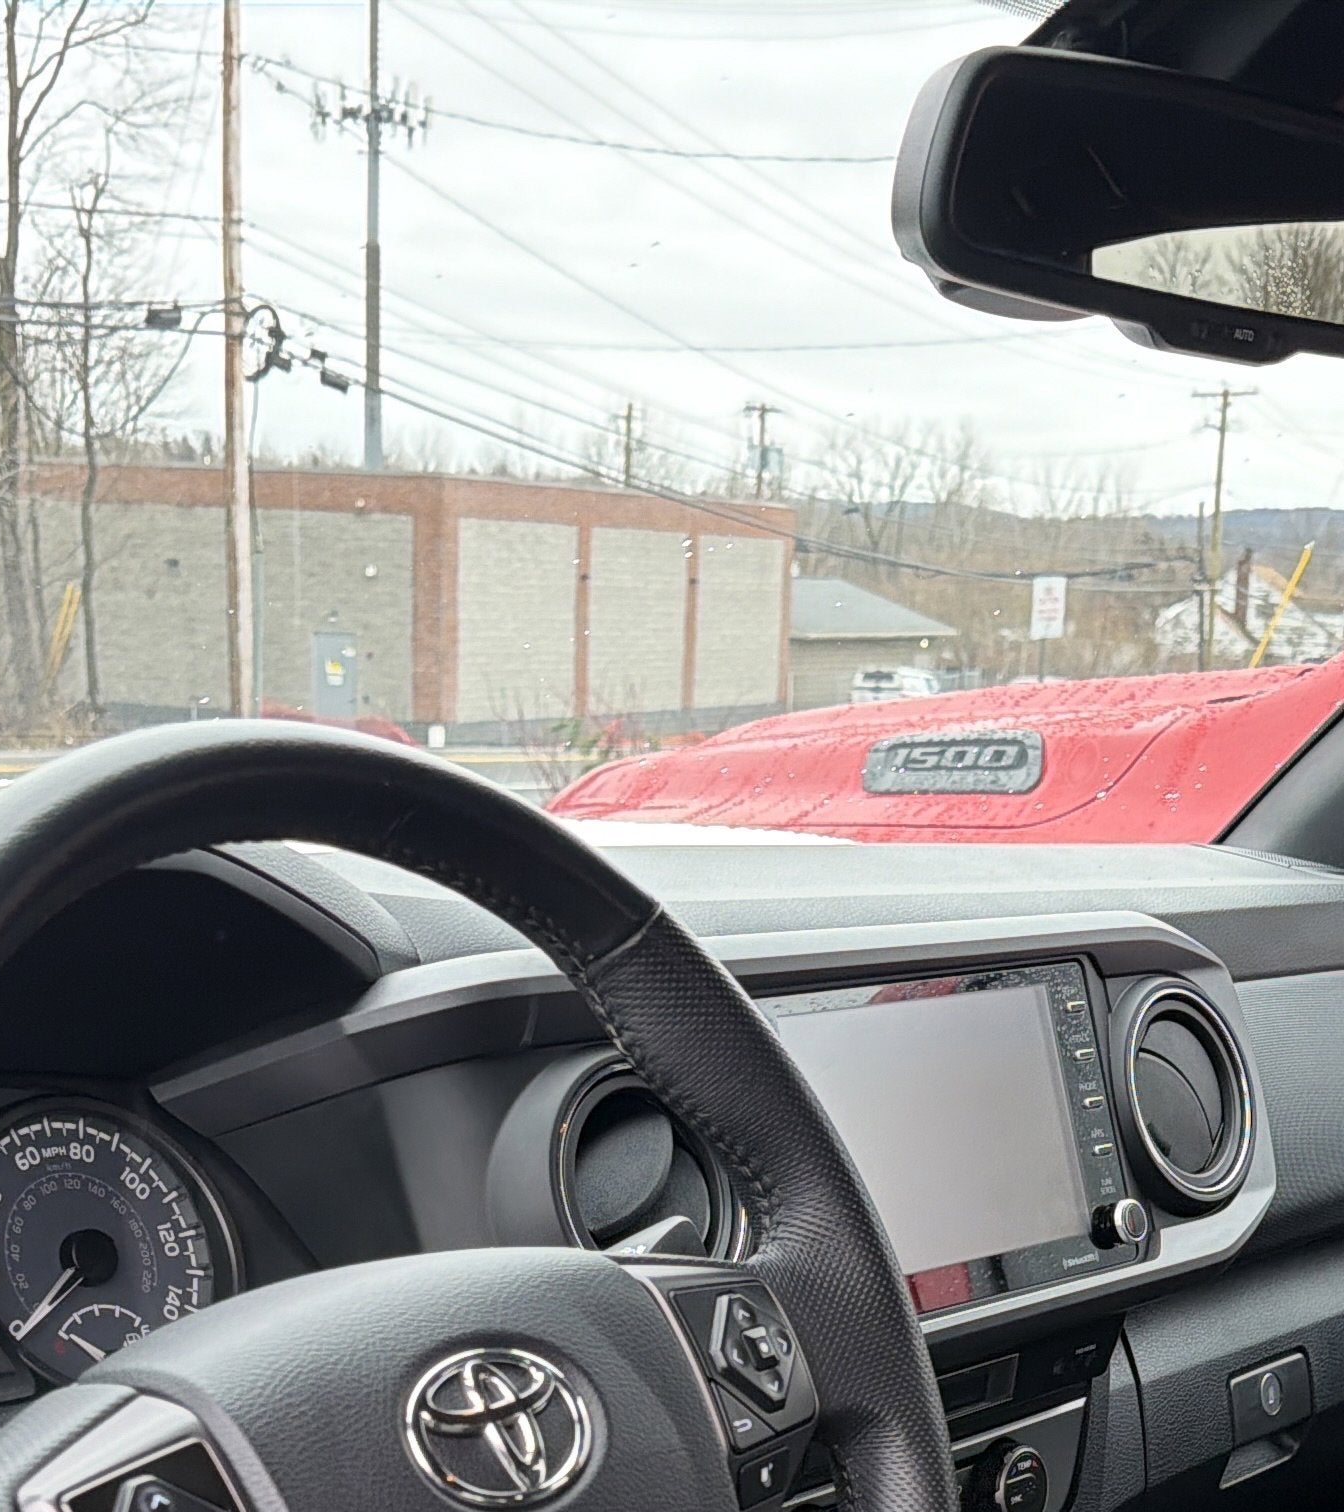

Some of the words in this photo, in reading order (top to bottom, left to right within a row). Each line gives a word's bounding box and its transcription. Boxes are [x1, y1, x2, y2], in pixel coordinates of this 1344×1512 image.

[1234, 328, 1255, 341] AUTO
[889, 744, 1020, 769] 1500
[15, 1146, 41, 1171] 60
[41, 1145, 67, 1158] MPH
[69, 1141, 95, 1163] 80
[39, 1181, 57, 1196] 100
[64, 1179, 80, 1189] 120
[88, 1182, 106, 1198] 140
[119, 1166, 150, 1200] 100
[110, 1196, 126, 1215] 160
[13, 1216, 24, 1234] 60
[128, 1218, 142, 1238] 180
[156, 1222, 180, 1257] 120
[10, 1244, 21, 1262] 40
[139, 1242, 152, 1266] 200
[16, 1273, 29, 1290] 20
[142, 1270, 152, 1293] 220
[163, 1285, 183, 1321] 140
[1017, 1459, 1032, 1470] TEMP
